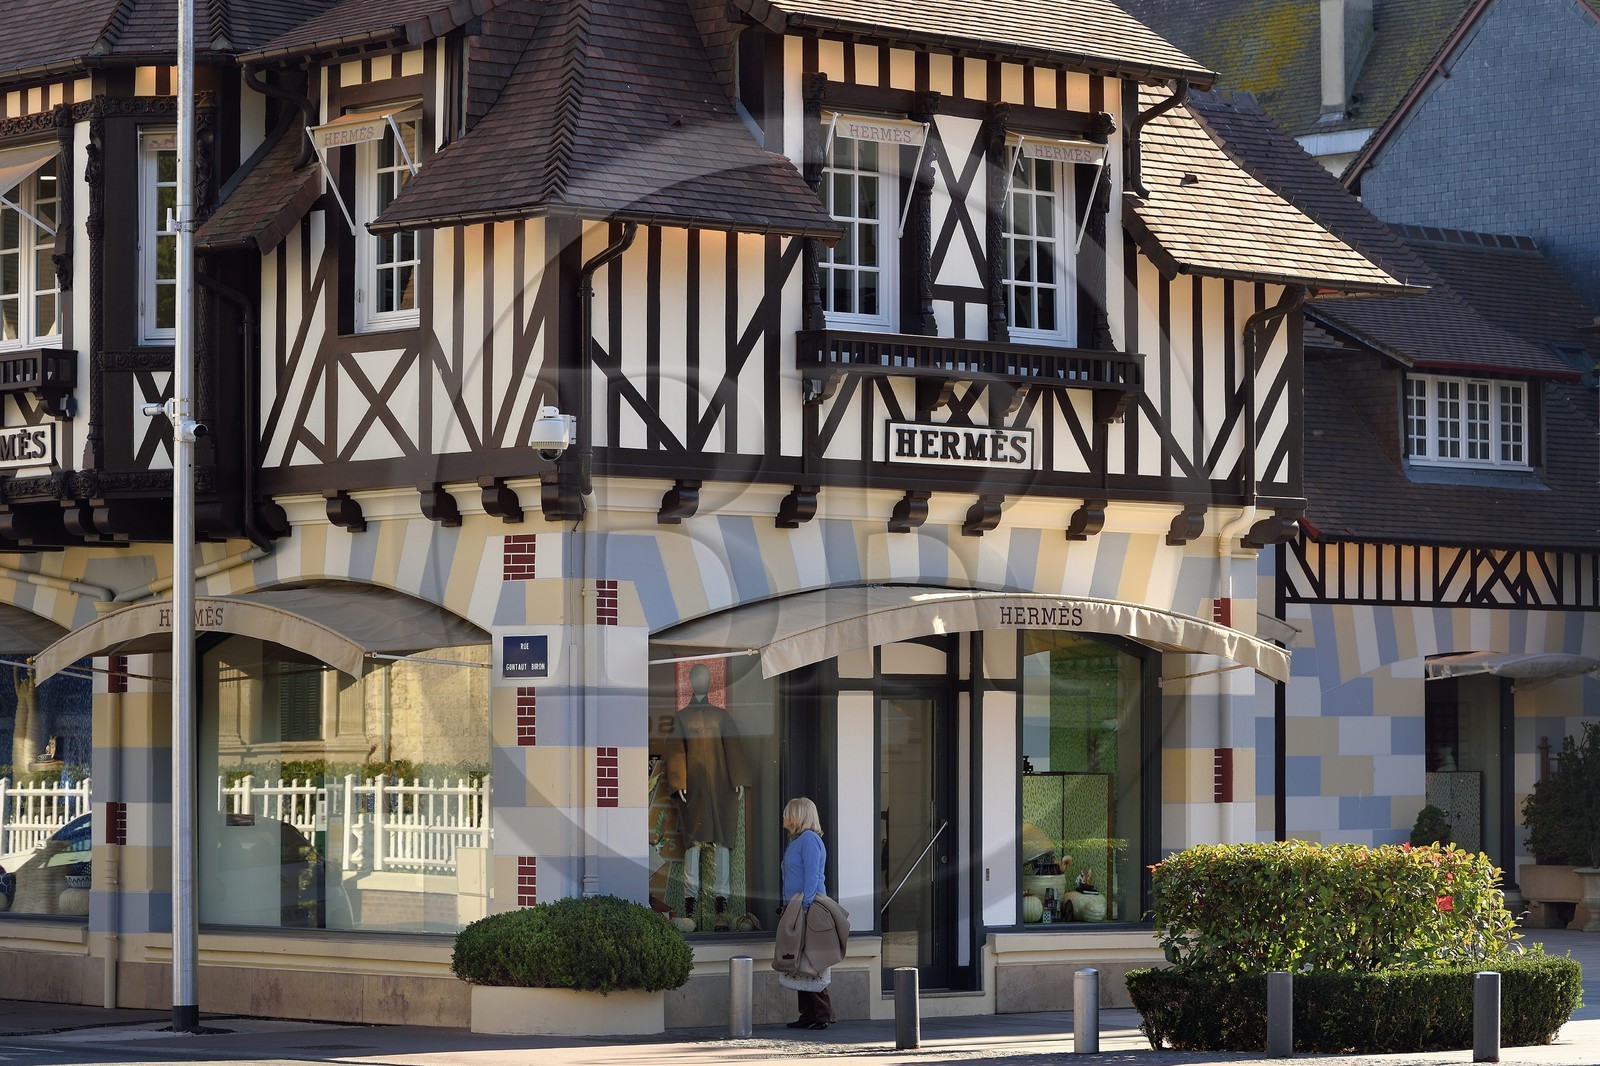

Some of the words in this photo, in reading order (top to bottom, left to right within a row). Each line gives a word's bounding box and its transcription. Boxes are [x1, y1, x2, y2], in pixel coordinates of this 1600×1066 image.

[323, 126, 375, 146] HERMÈS
[849, 123, 912, 144] HERMÈS
[1033, 144, 1092, 163] HERMÈS
[0, 429, 46, 461] MÈS
[895, 428, 1027, 464] HERMÈS
[159, 606, 224, 627] HMÈS
[999, 605, 1083, 627] HERMÈS
[520, 642, 530, 650] RUE
[506, 663, 527, 671] GONTAUT
[531, 662, 546, 671] BIRON
